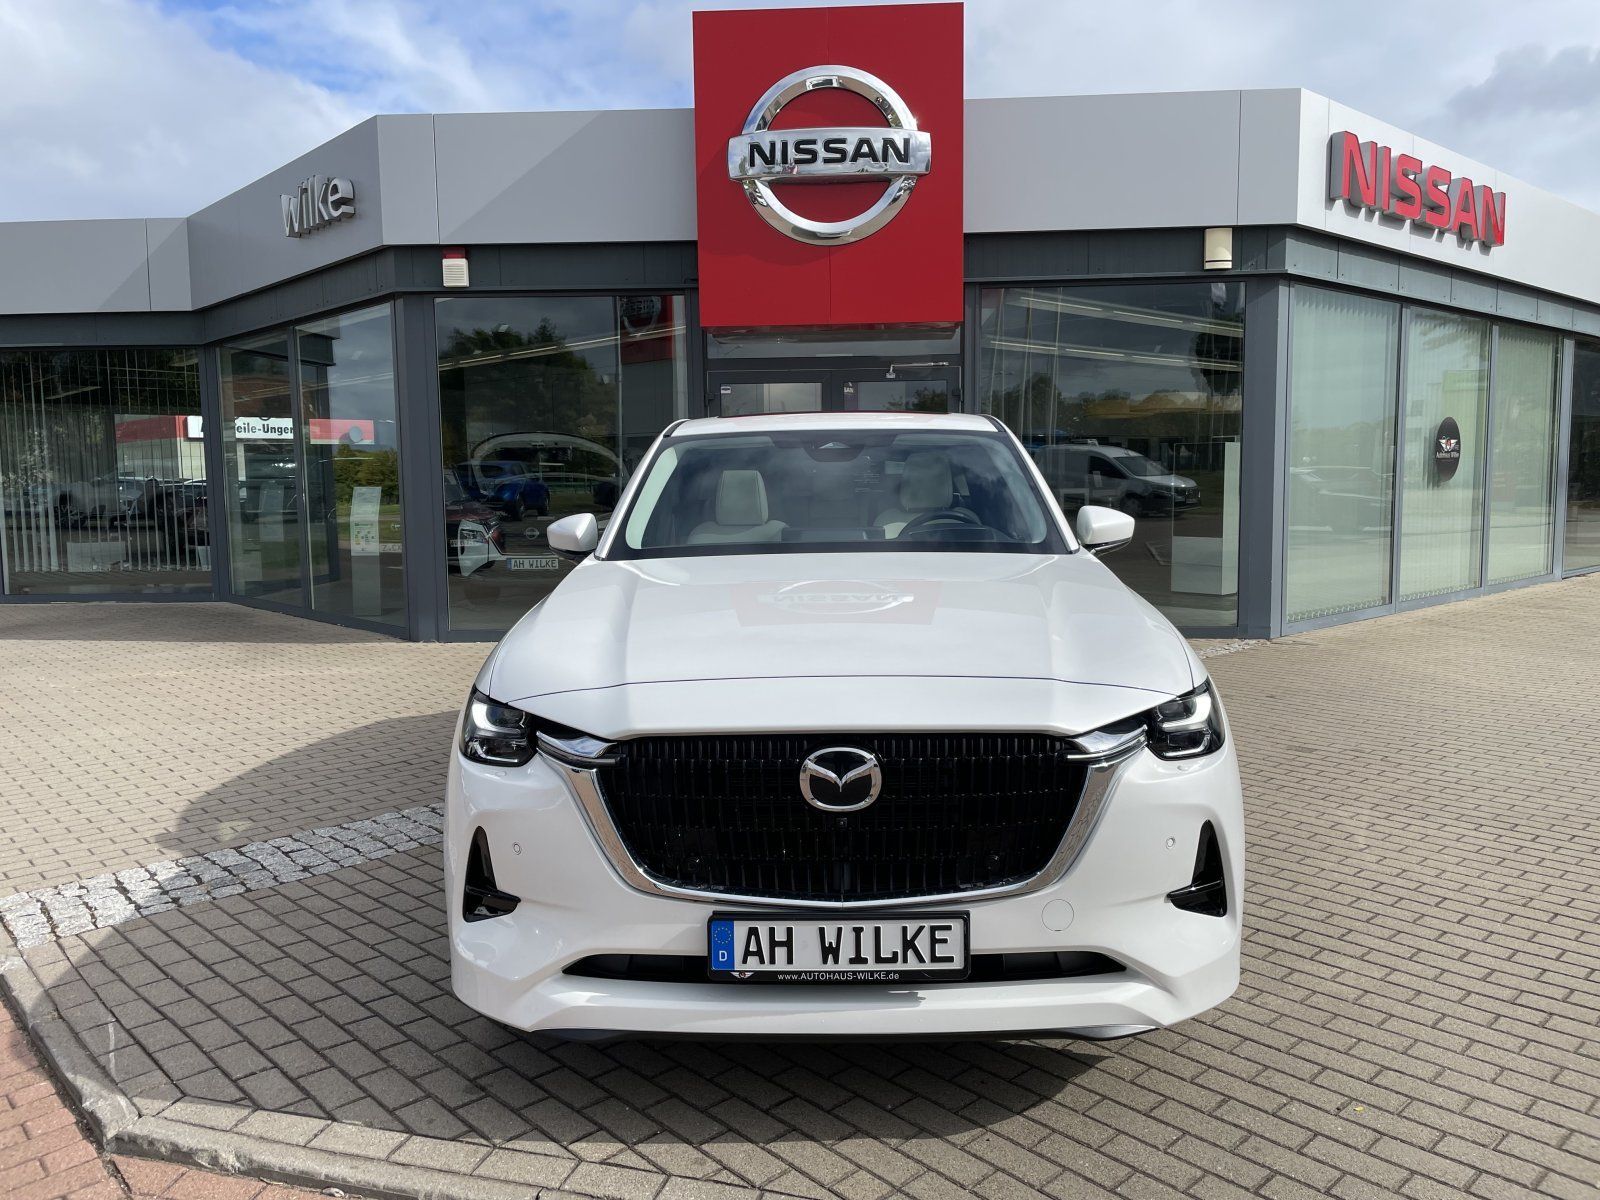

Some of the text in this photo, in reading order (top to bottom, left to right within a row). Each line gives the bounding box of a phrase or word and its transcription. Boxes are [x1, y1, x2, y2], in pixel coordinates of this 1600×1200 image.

[748, 137, 911, 168] NISSAN
[1332, 131, 1506, 247] NISSAN
[280, 175, 355, 238] wilke
[236, 422, 294, 436] eile-Unger
[513, 559, 557, 568] AH WILKE
[718, 950, 728, 962] D
[741, 925, 955, 965] AH WILKE
[777, 971, 900, 981] www.AUTOHAUS-WILKE.de
